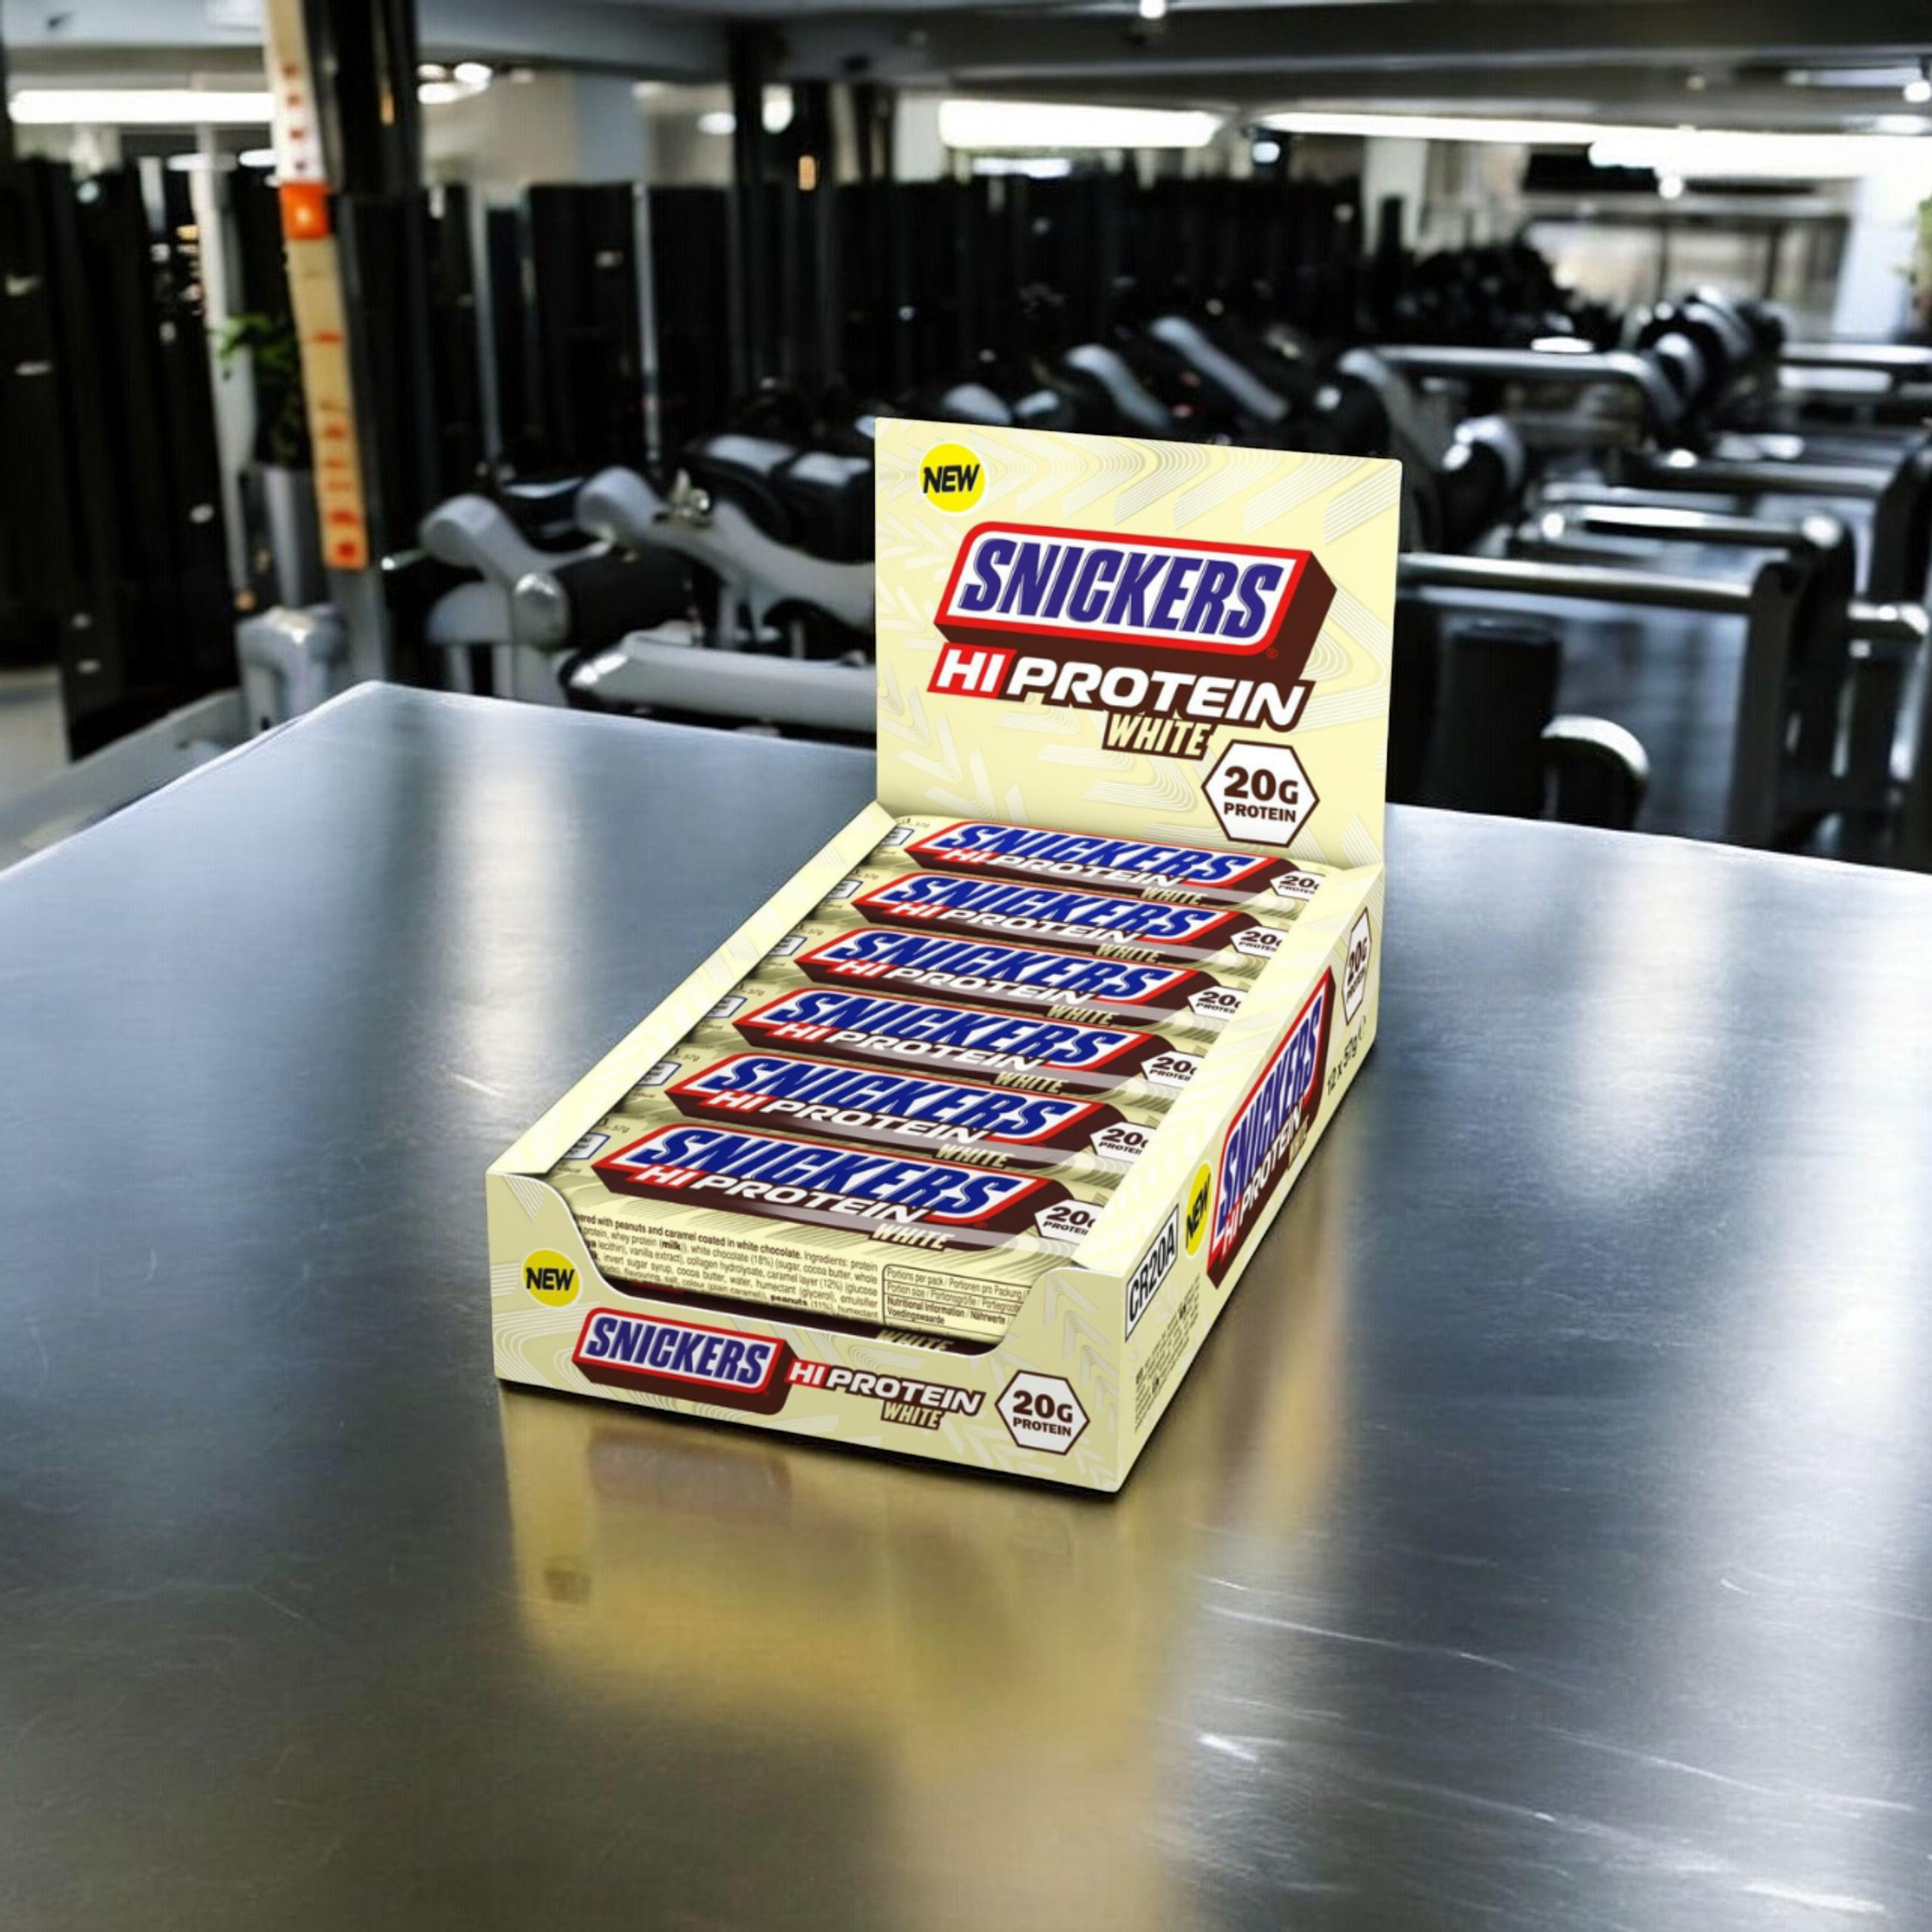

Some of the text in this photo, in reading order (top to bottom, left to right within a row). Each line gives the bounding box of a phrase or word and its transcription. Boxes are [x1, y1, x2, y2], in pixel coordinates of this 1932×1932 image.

[923, 464, 980, 494] NEW
[958, 537, 1284, 639] SNICKERS
[935, 649, 1306, 727] HI PROTEIN
[1106, 712, 1211, 756] WHITE
[1223, 766, 1299, 804] 20G
[1223, 802, 1297, 823] PROTEIN
[933, 825, 1257, 880] SNICKERS
[940, 850, 1183, 887] HI PROTEIN
[881, 876, 1218, 936] SNICKERS
[1140, 887, 1208, 905] WHITE
[891, 902, 1142, 943] HI PROTEIN
[823, 932, 1174, 997] SNICKERS
[1097, 943, 1164, 964] WHITE
[833, 961, 1094, 1004] HI PROTEIN
[763, 992, 1128, 1063] SNICKERS
[1047, 1004, 1118, 1026] WHITE
[773, 1023, 1044, 1071] HI PROTEIN
[698, 1058, 1084, 1134] SNICKERS
[994, 1071, 1068, 1094] WHITE
[708, 1090, 983, 1144] HI PROTEIN
[1216, 993, 1323, 1238] SNICKERS
[626, 1130, 1022, 1214] SNICKERS
[937, 1143, 1013, 1168] WHITE
[1240, 1103, 1303, 1215] PROTEIN
[635, 1167, 928, 1223] HI PROTEIN
[1186, 1171, 1211, 1248] NEW
[597, 1217, 613, 1226] with
[615, 1220, 645, 1233] peanuts
[648, 1226, 663, 1235] and
[665, 1228, 696, 1241] caramel
[697, 1233, 725, 1246] coated
[727, 1238, 734, 1247] in
[737, 1239, 758, 1251] white
[760, 1244, 801, 1259] chocolate.
[851, 1260, 877, 1273] protein
[872, 1223, 955, 1250] WHITE
[525, 1267, 575, 1291] NEW
[627, 1259, 647, 1269] sugar
[676, 1266, 699, 1277] cocoa
[629, 1246, 653, 1257] vanilla
[687, 1255, 718, 1270] collagen
[767, 1269, 797, 1282] caramel
[799, 1274, 817, 1287] layer
[632, 1235, 656, 1247] protein
[691, 1244, 711, 1255] white
[712, 1247, 747, 1262] chocolate
[750, 1254, 773, 1267] (18%)
[802, 1263, 826, 1275] cocoa
[854, 1272, 877, 1284] whole
[928, 1275, 943, 1286] pack
[1129, 1222, 1175, 1322] CR20A
[586, 1316, 771, 1385] SNICKERS
[789, 1361, 981, 1414] HI PROTEIN
[1012, 1389, 1073, 1423] 20G
[882, 1402, 943, 1429] WHITE
[1012, 1417, 1072, 1437] PROTEIN
